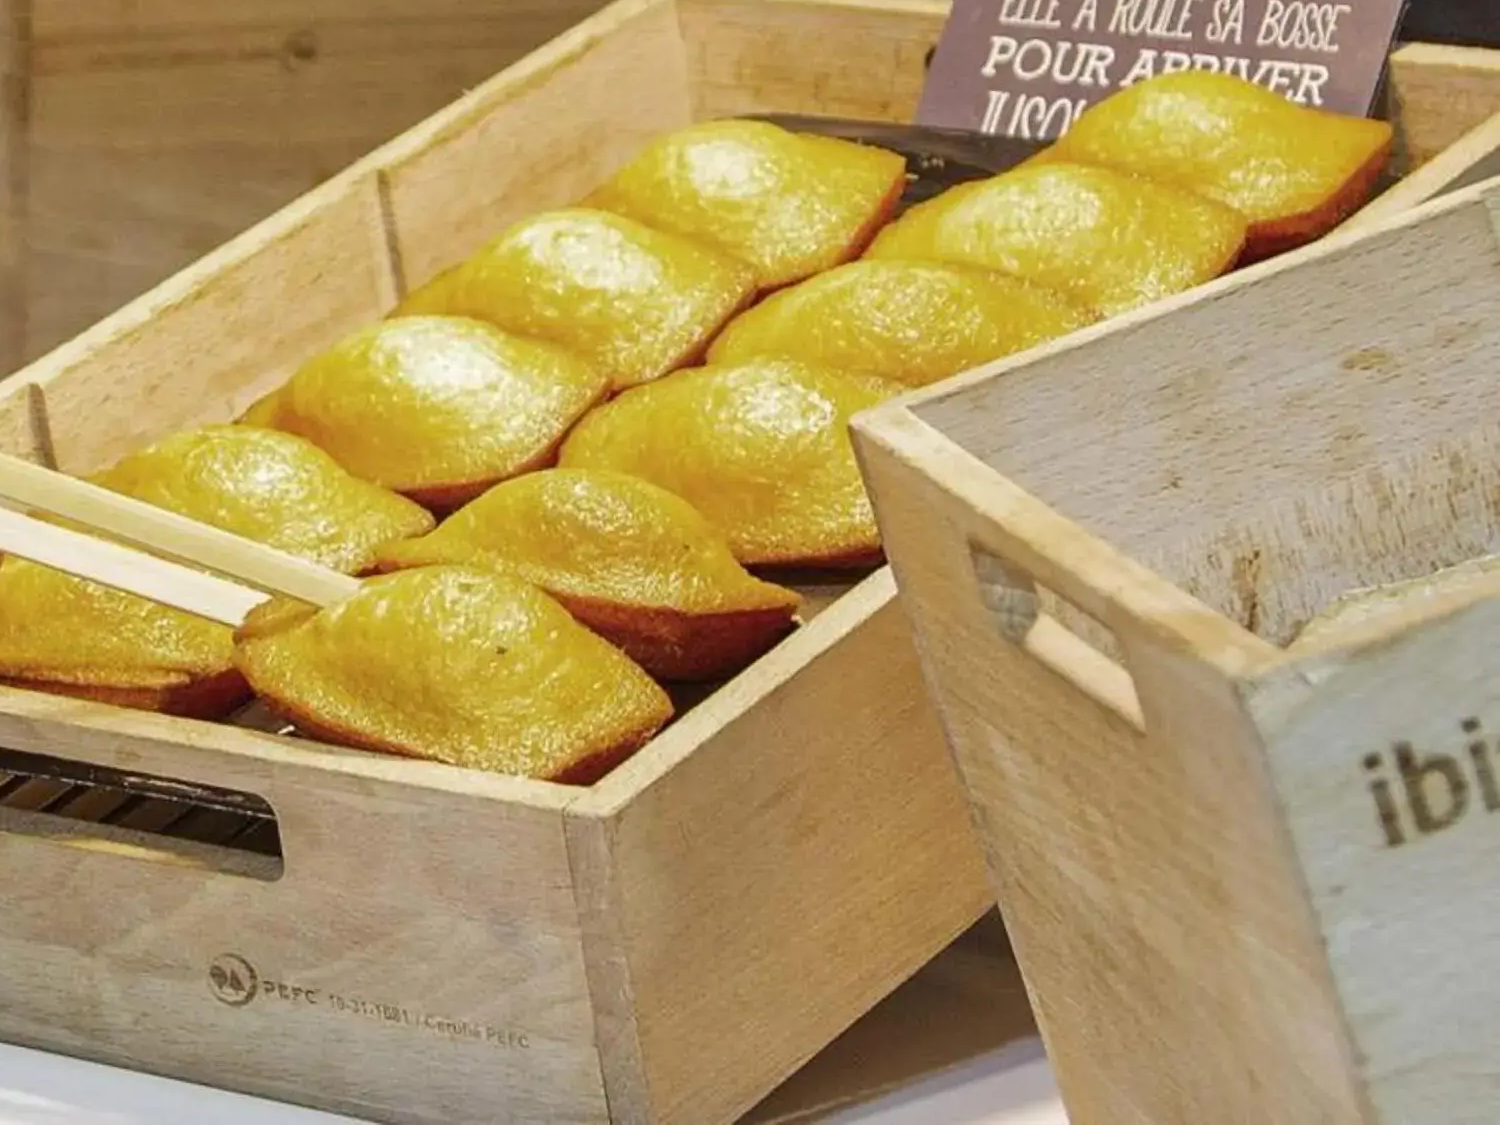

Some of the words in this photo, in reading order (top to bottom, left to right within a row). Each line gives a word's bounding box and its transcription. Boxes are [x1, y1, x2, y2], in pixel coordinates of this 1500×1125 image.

[1255, 0, 1351, 53] BOSSE
[981, 36, 1116, 87] POUR
[981, 90, 1088, 139] JUSQ
[1362, 716, 1500, 848] ibi
[262, 980, 318, 1005] PEFC
